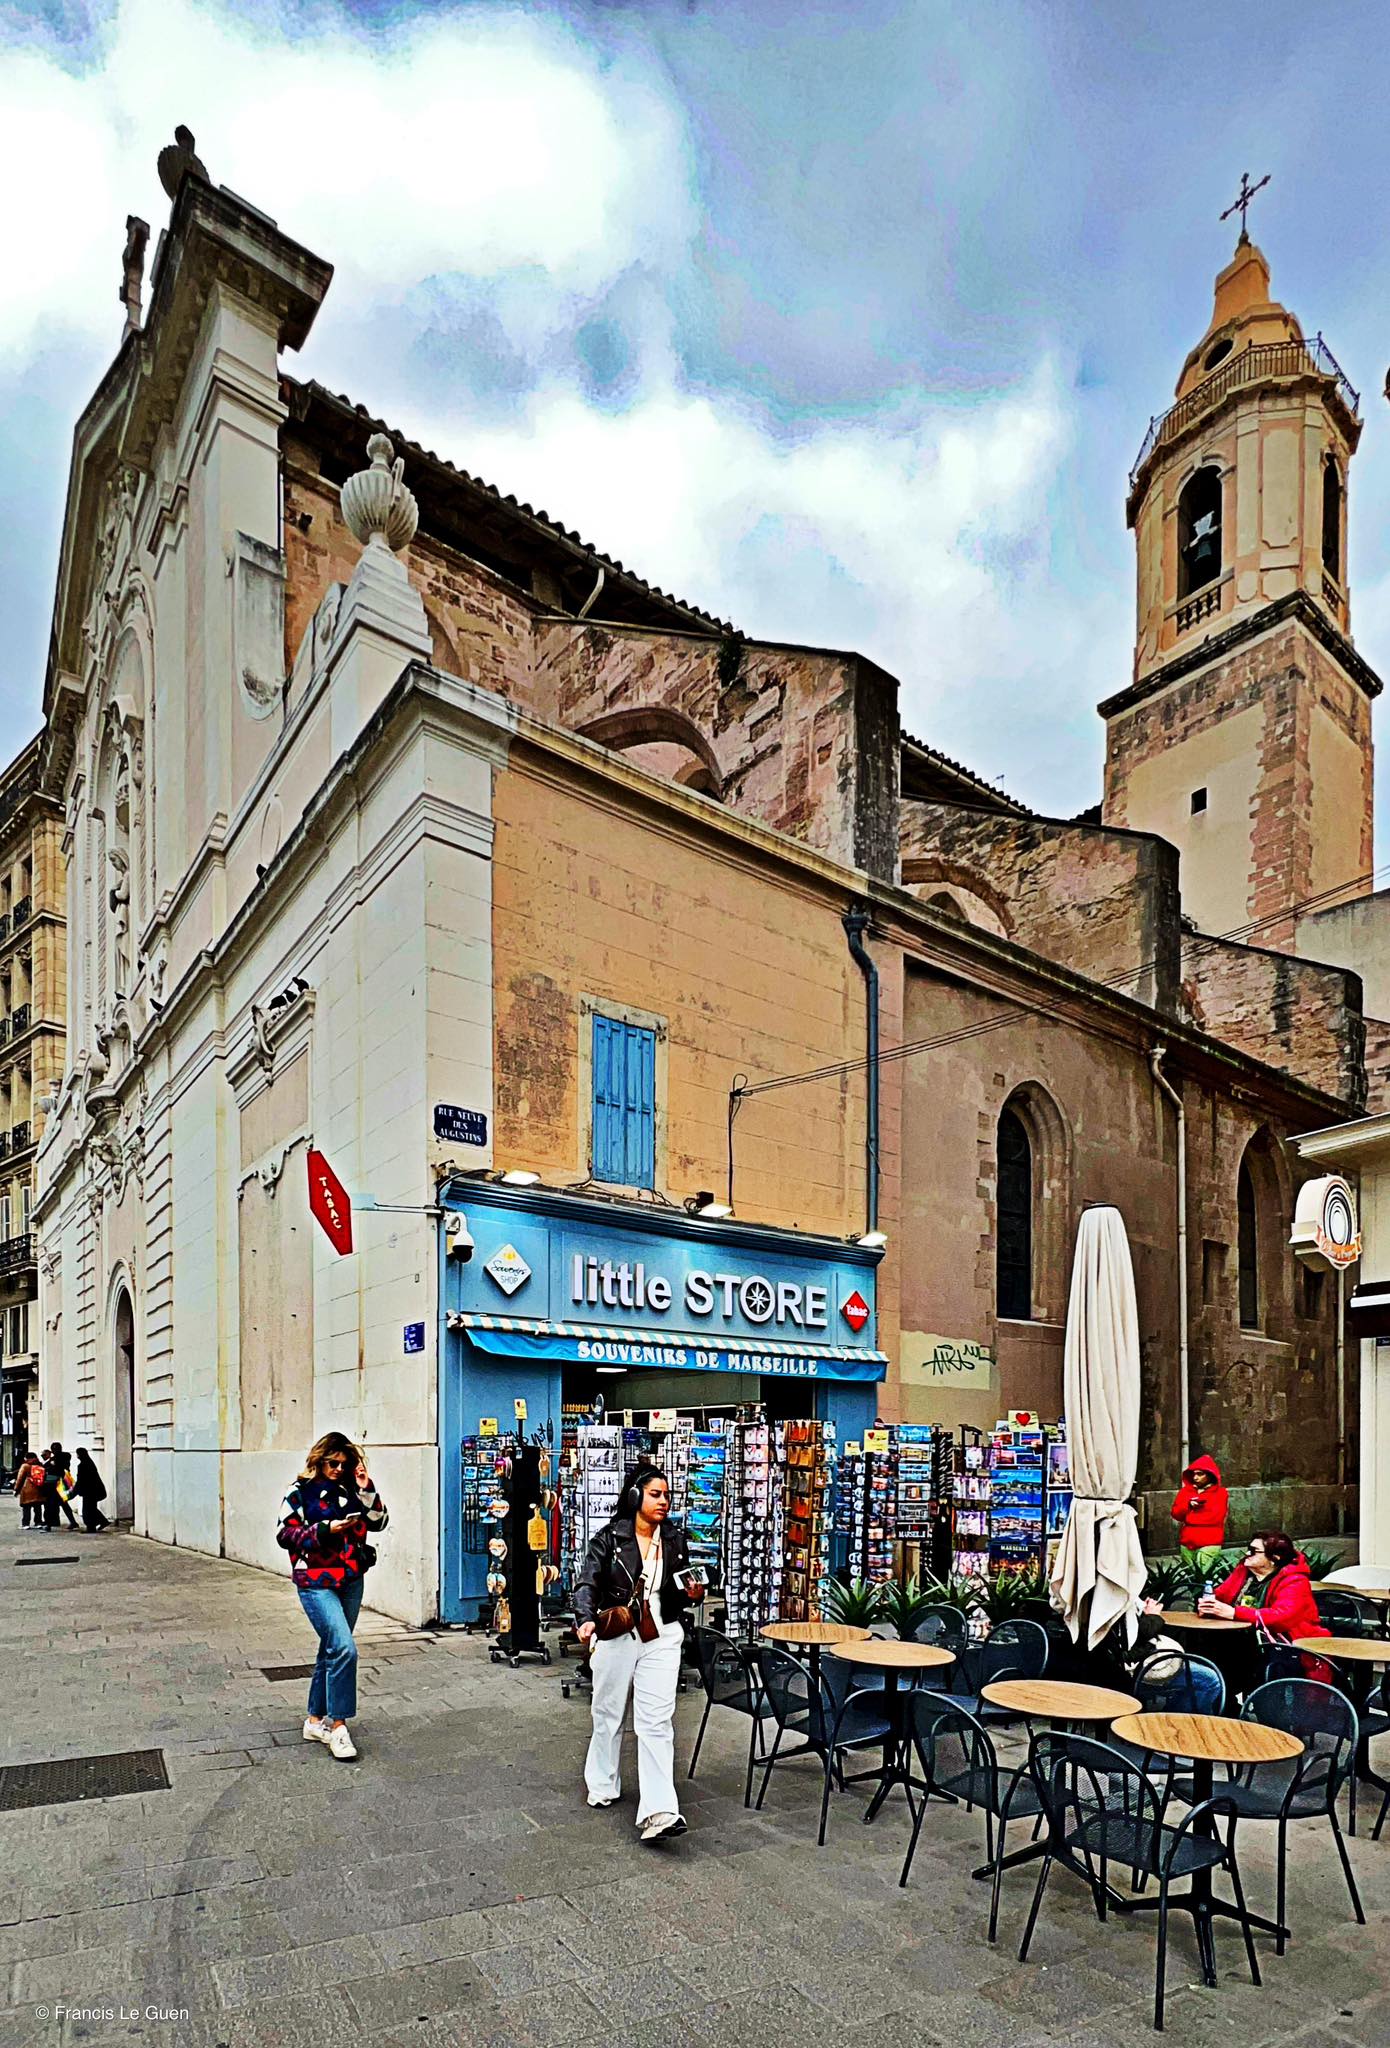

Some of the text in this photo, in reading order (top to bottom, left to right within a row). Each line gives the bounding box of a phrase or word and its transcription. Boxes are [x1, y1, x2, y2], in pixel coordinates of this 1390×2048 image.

[438, 1107, 483, 1123] RUE NEUVE
[453, 1120, 468, 1130] DES
[440, 1127, 482, 1143] AUGUSTINS
[318, 1176, 342, 1229] TABAC
[500, 1275, 519, 1284] SHOP
[571, 1254, 828, 1327] little STORE
[846, 1304, 868, 1317] Tabac
[577, 1340, 818, 1376] SOUVENIRS DE MARSEILLE
